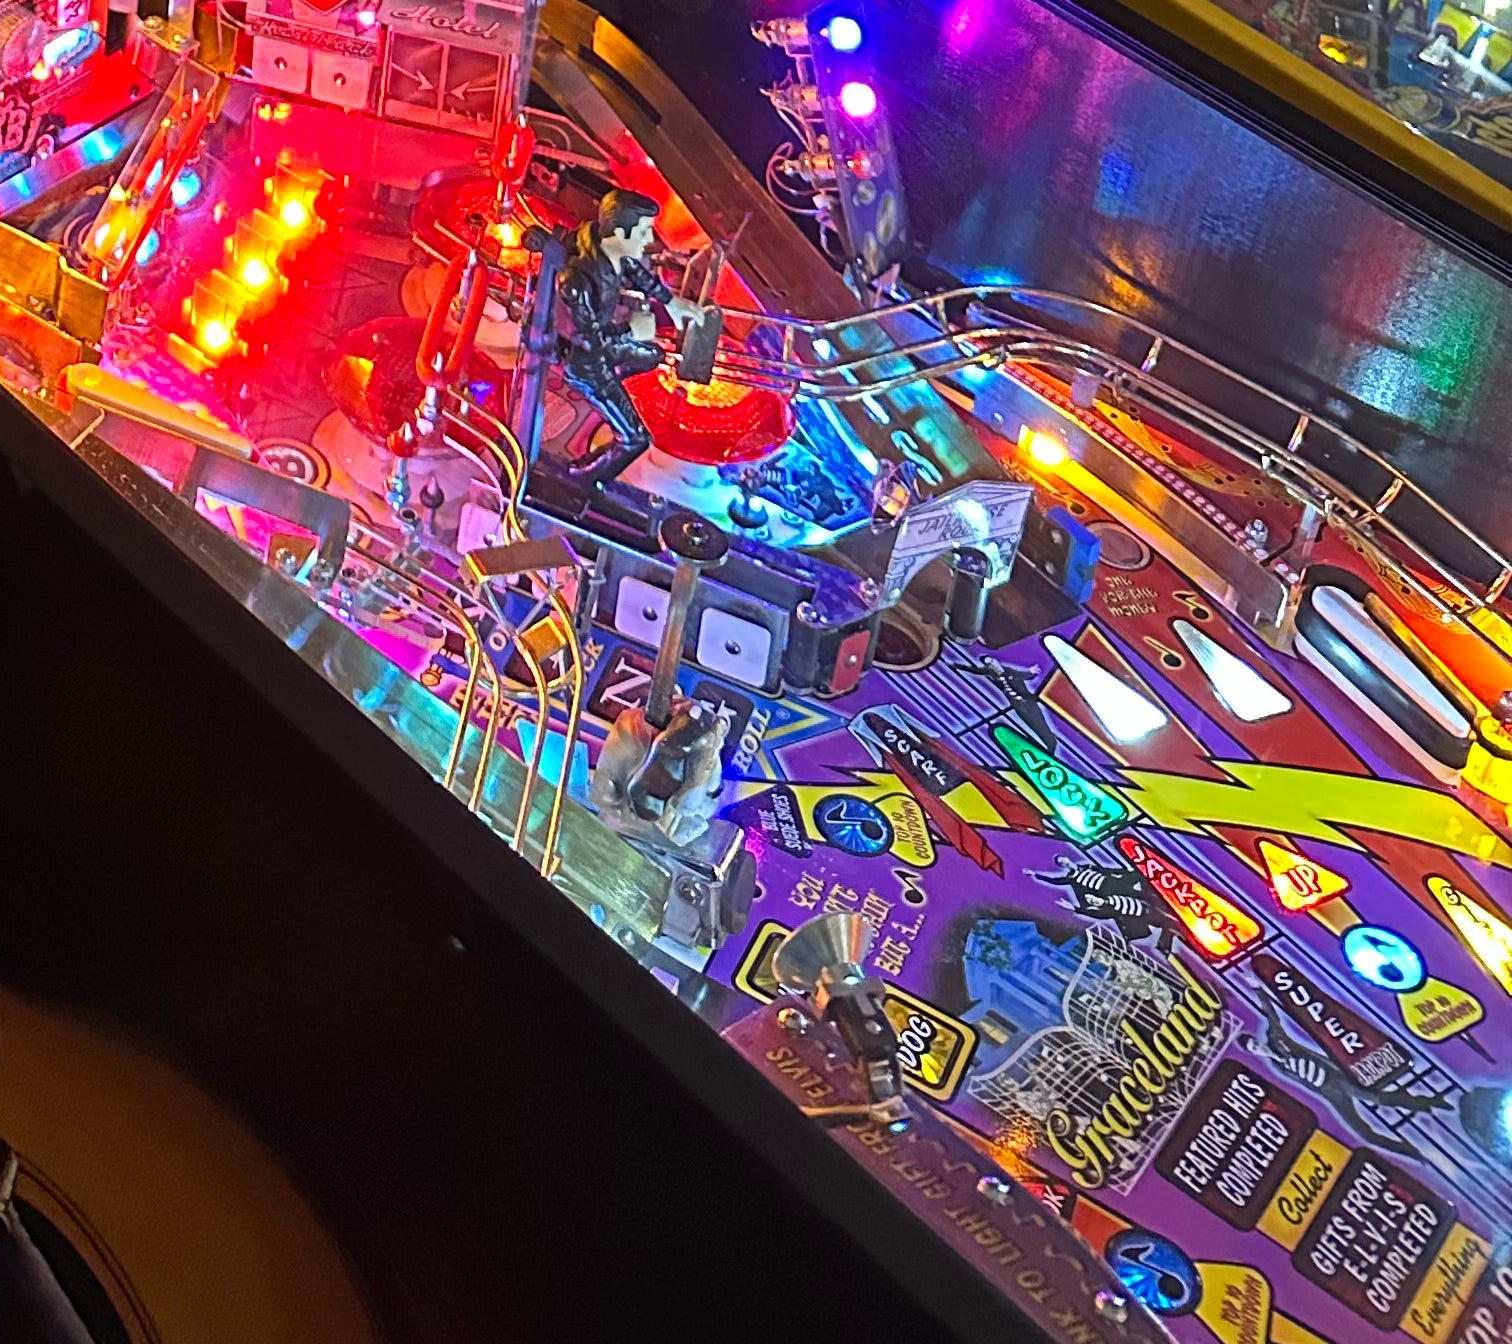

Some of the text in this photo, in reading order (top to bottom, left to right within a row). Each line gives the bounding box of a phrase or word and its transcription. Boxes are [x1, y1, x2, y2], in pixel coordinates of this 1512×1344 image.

[390, 3, 499, 40] Hotel
[730, 706, 771, 774] ROLL
[884, 728, 948, 787] SCARF
[1019, 749, 1112, 827] LOCK
[895, 822, 909, 843] TOP
[899, 798, 930, 861] COUNTDOWN
[1131, 839, 1240, 944] JACKPOT
[1288, 864, 1320, 898] UP
[874, 936, 912, 976] BUT
[1273, 971, 1365, 1055] SUPER
[765, 1047, 835, 1099] ELVIS
[1045, 953, 1224, 1189] Graceland
[1349, 1042, 1405, 1087] JACKPOT
[1173, 1072, 1266, 1193] FEATURED HITS
[1214, 1113, 1290, 1207] COMPLETED
[890, 1159, 950, 1199] GIFT
[1278, 1151, 1334, 1225] Collect
[943, 1206, 1022, 1264] LIGHT
[1310, 1162, 1387, 1276] GIFTS FROM
[1017, 1268, 1052, 1305] TO
[1365, 1204, 1439, 1313] COMPLETED
